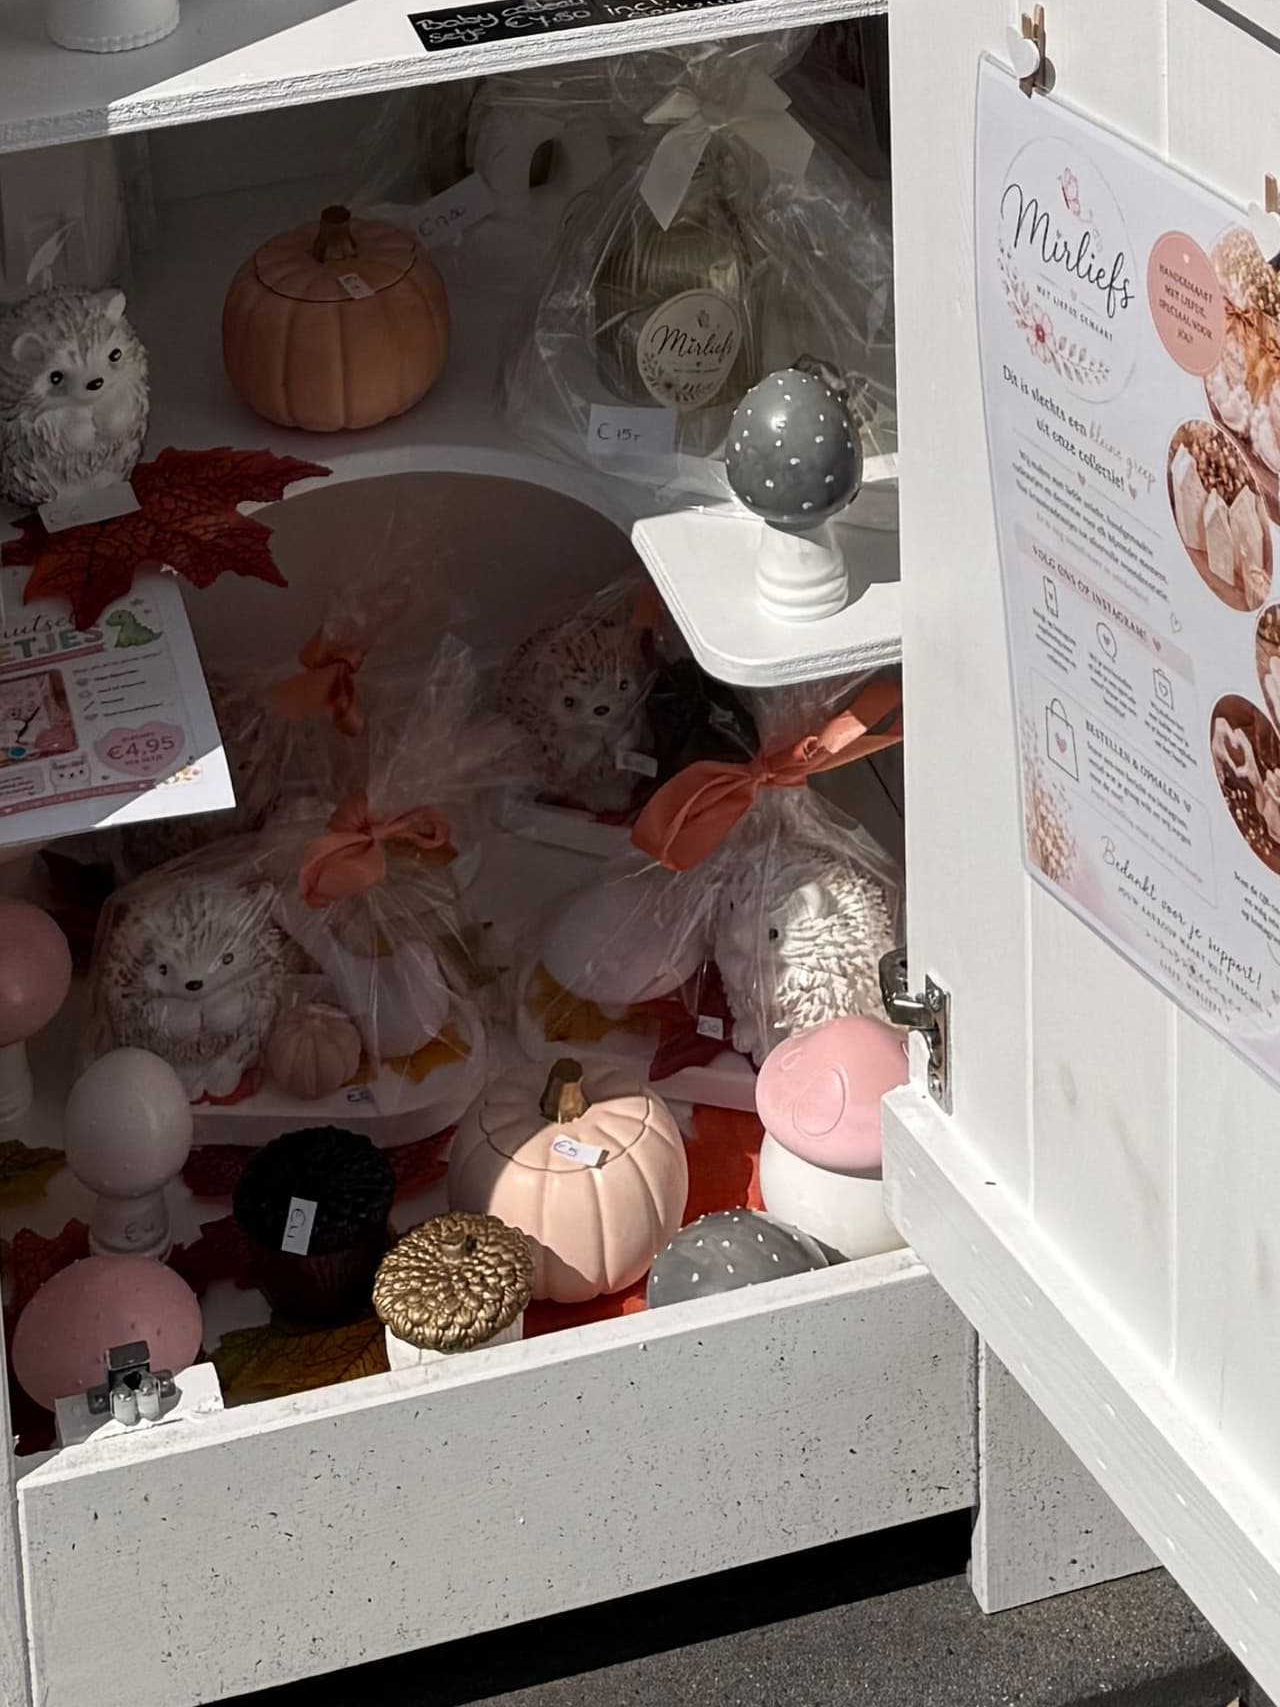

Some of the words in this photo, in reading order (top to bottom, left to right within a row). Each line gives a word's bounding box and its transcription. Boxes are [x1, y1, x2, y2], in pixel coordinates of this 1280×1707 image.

[417, 12, 500, 31] Baby
[1000, 183, 1136, 320] Mirliefs
[650, 324, 735, 364] Mirliefs
[1002, 364, 1019, 388] Dit
[1031, 387, 1067, 423] slechts
[1068, 415, 1088, 438] een
[1036, 417, 1051, 440] uit
[1052, 430, 1078, 457] onze
[1101, 833, 1157, 901] Bedankt
[1160, 899, 1186, 926] voor
[1188, 924, 1202, 941] je
[1207, 936, 1262, 991] support!
